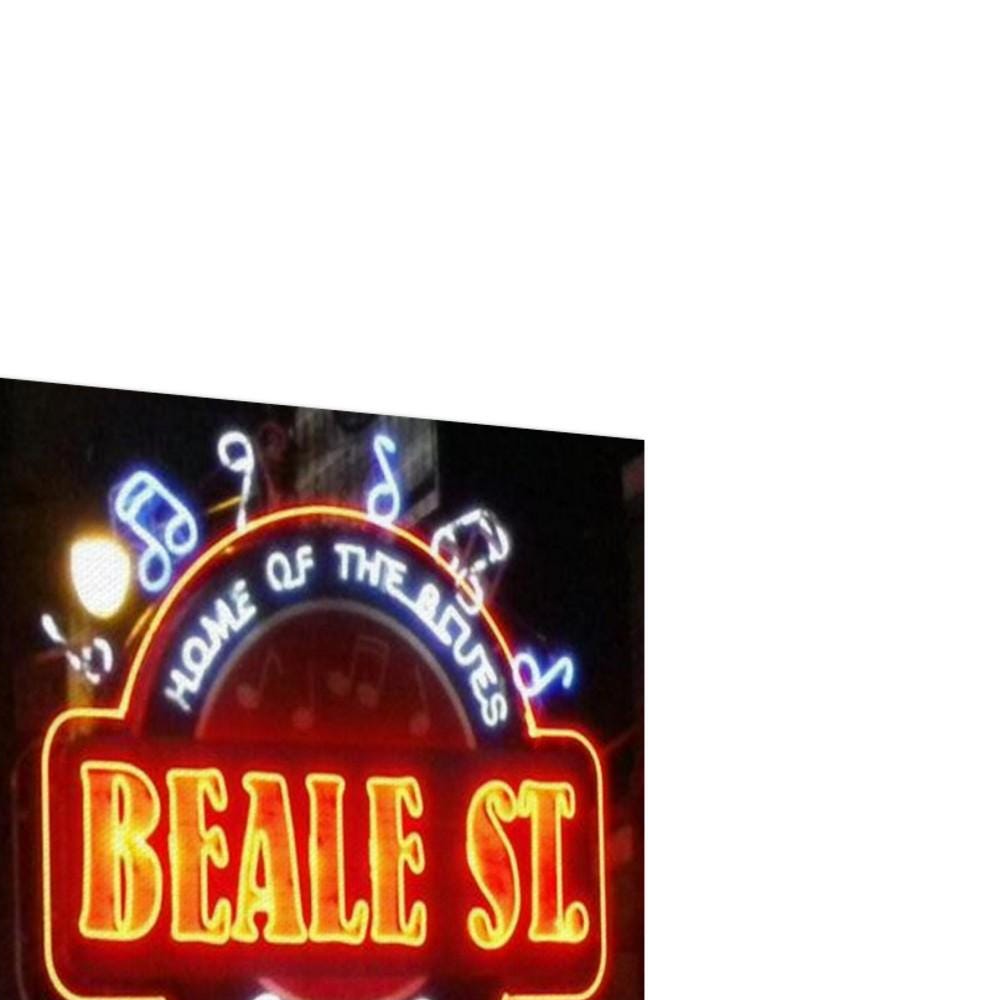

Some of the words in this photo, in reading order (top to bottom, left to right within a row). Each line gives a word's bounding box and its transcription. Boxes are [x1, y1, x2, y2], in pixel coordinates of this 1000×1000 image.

[164, 578, 257, 712] HOME
[265, 545, 315, 592] OF
[333, 542, 409, 597] THE
[411, 582, 509, 728] BLUES
[78, 760, 427, 945] BEALE
